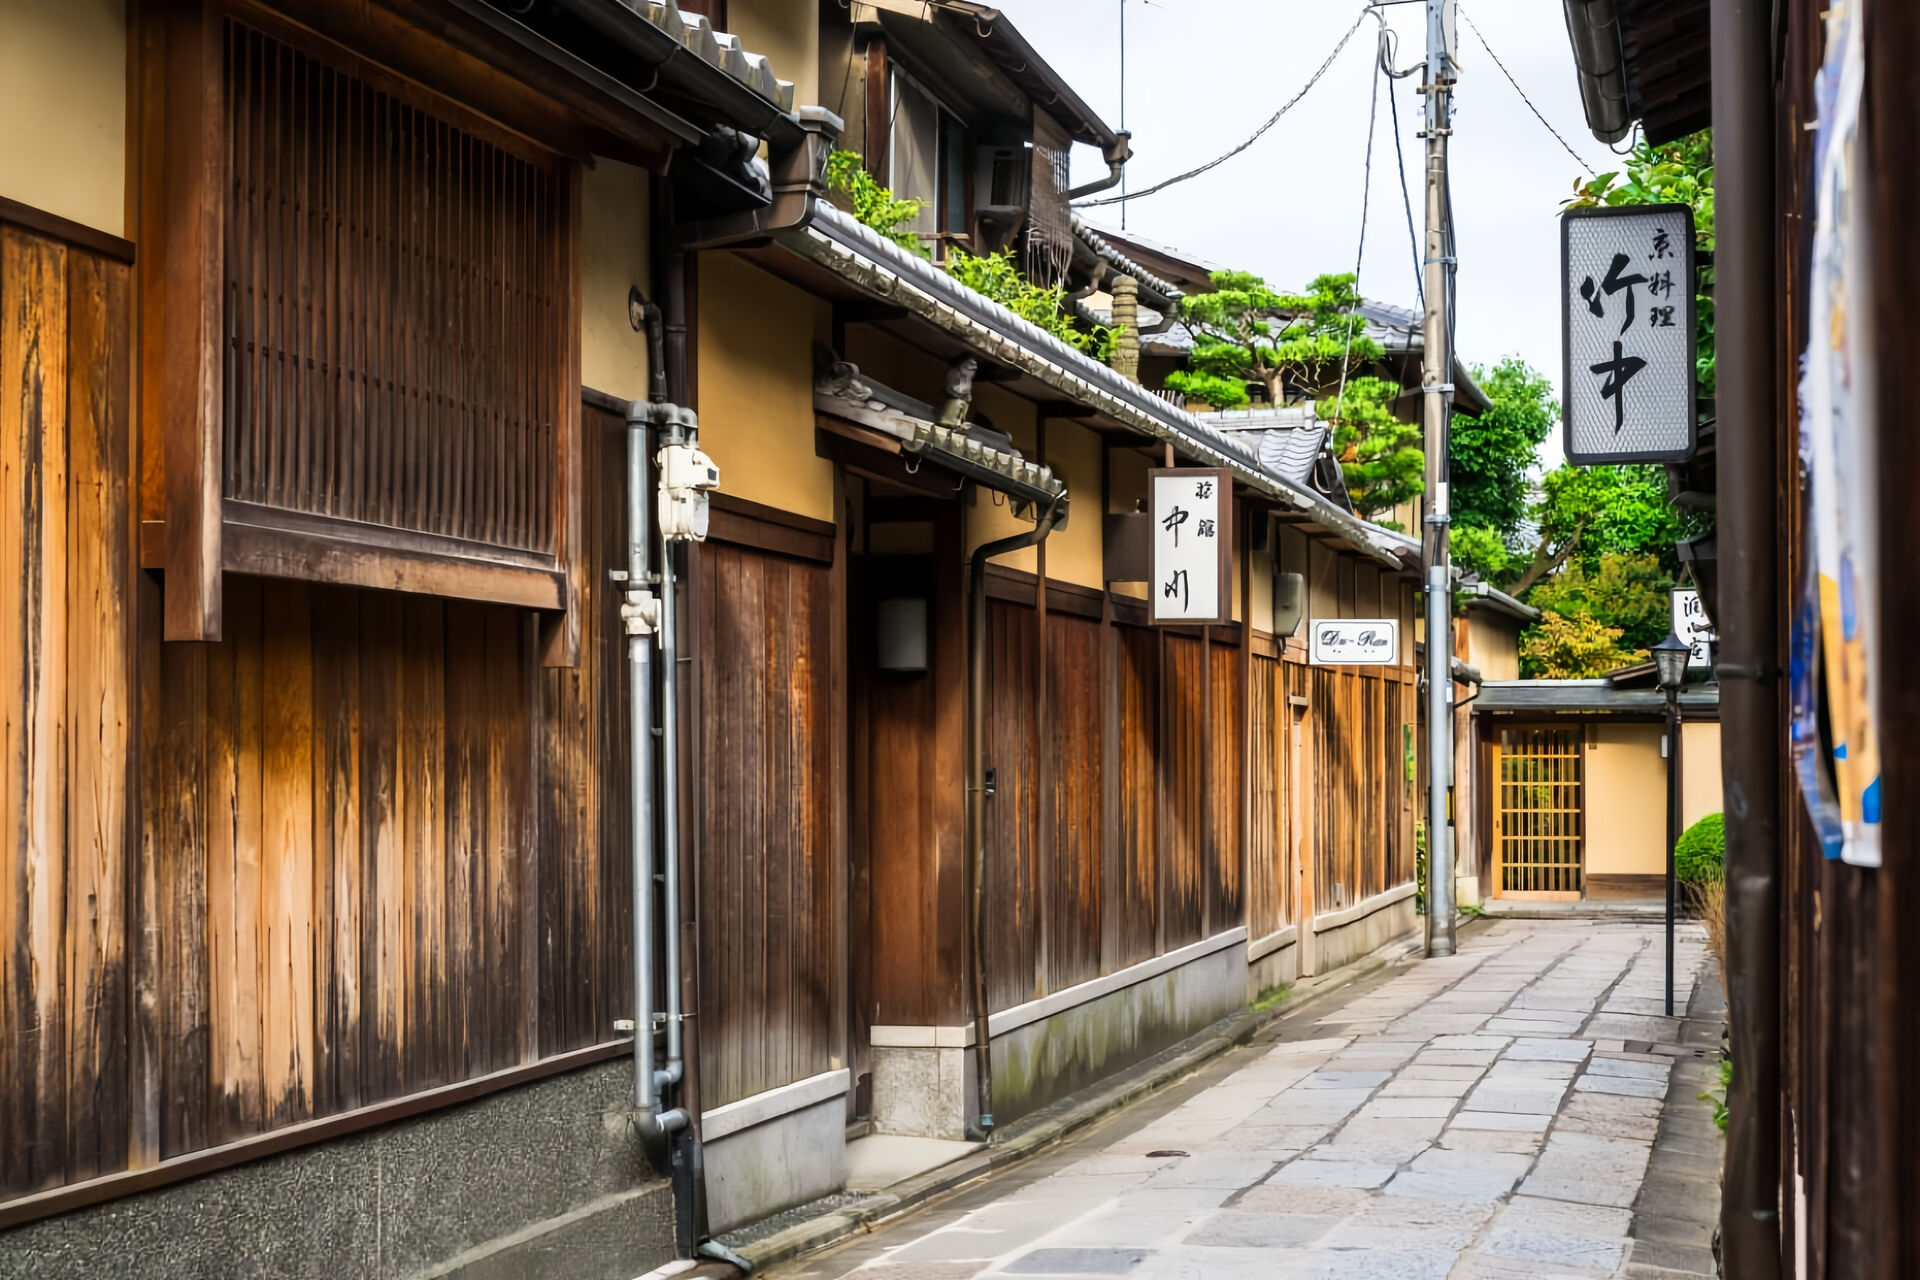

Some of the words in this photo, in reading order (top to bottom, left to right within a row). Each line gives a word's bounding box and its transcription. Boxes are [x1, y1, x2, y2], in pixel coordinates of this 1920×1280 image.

[1580, 253, 1649, 436] 竹中
[1649, 228, 1676, 328] 京料理
